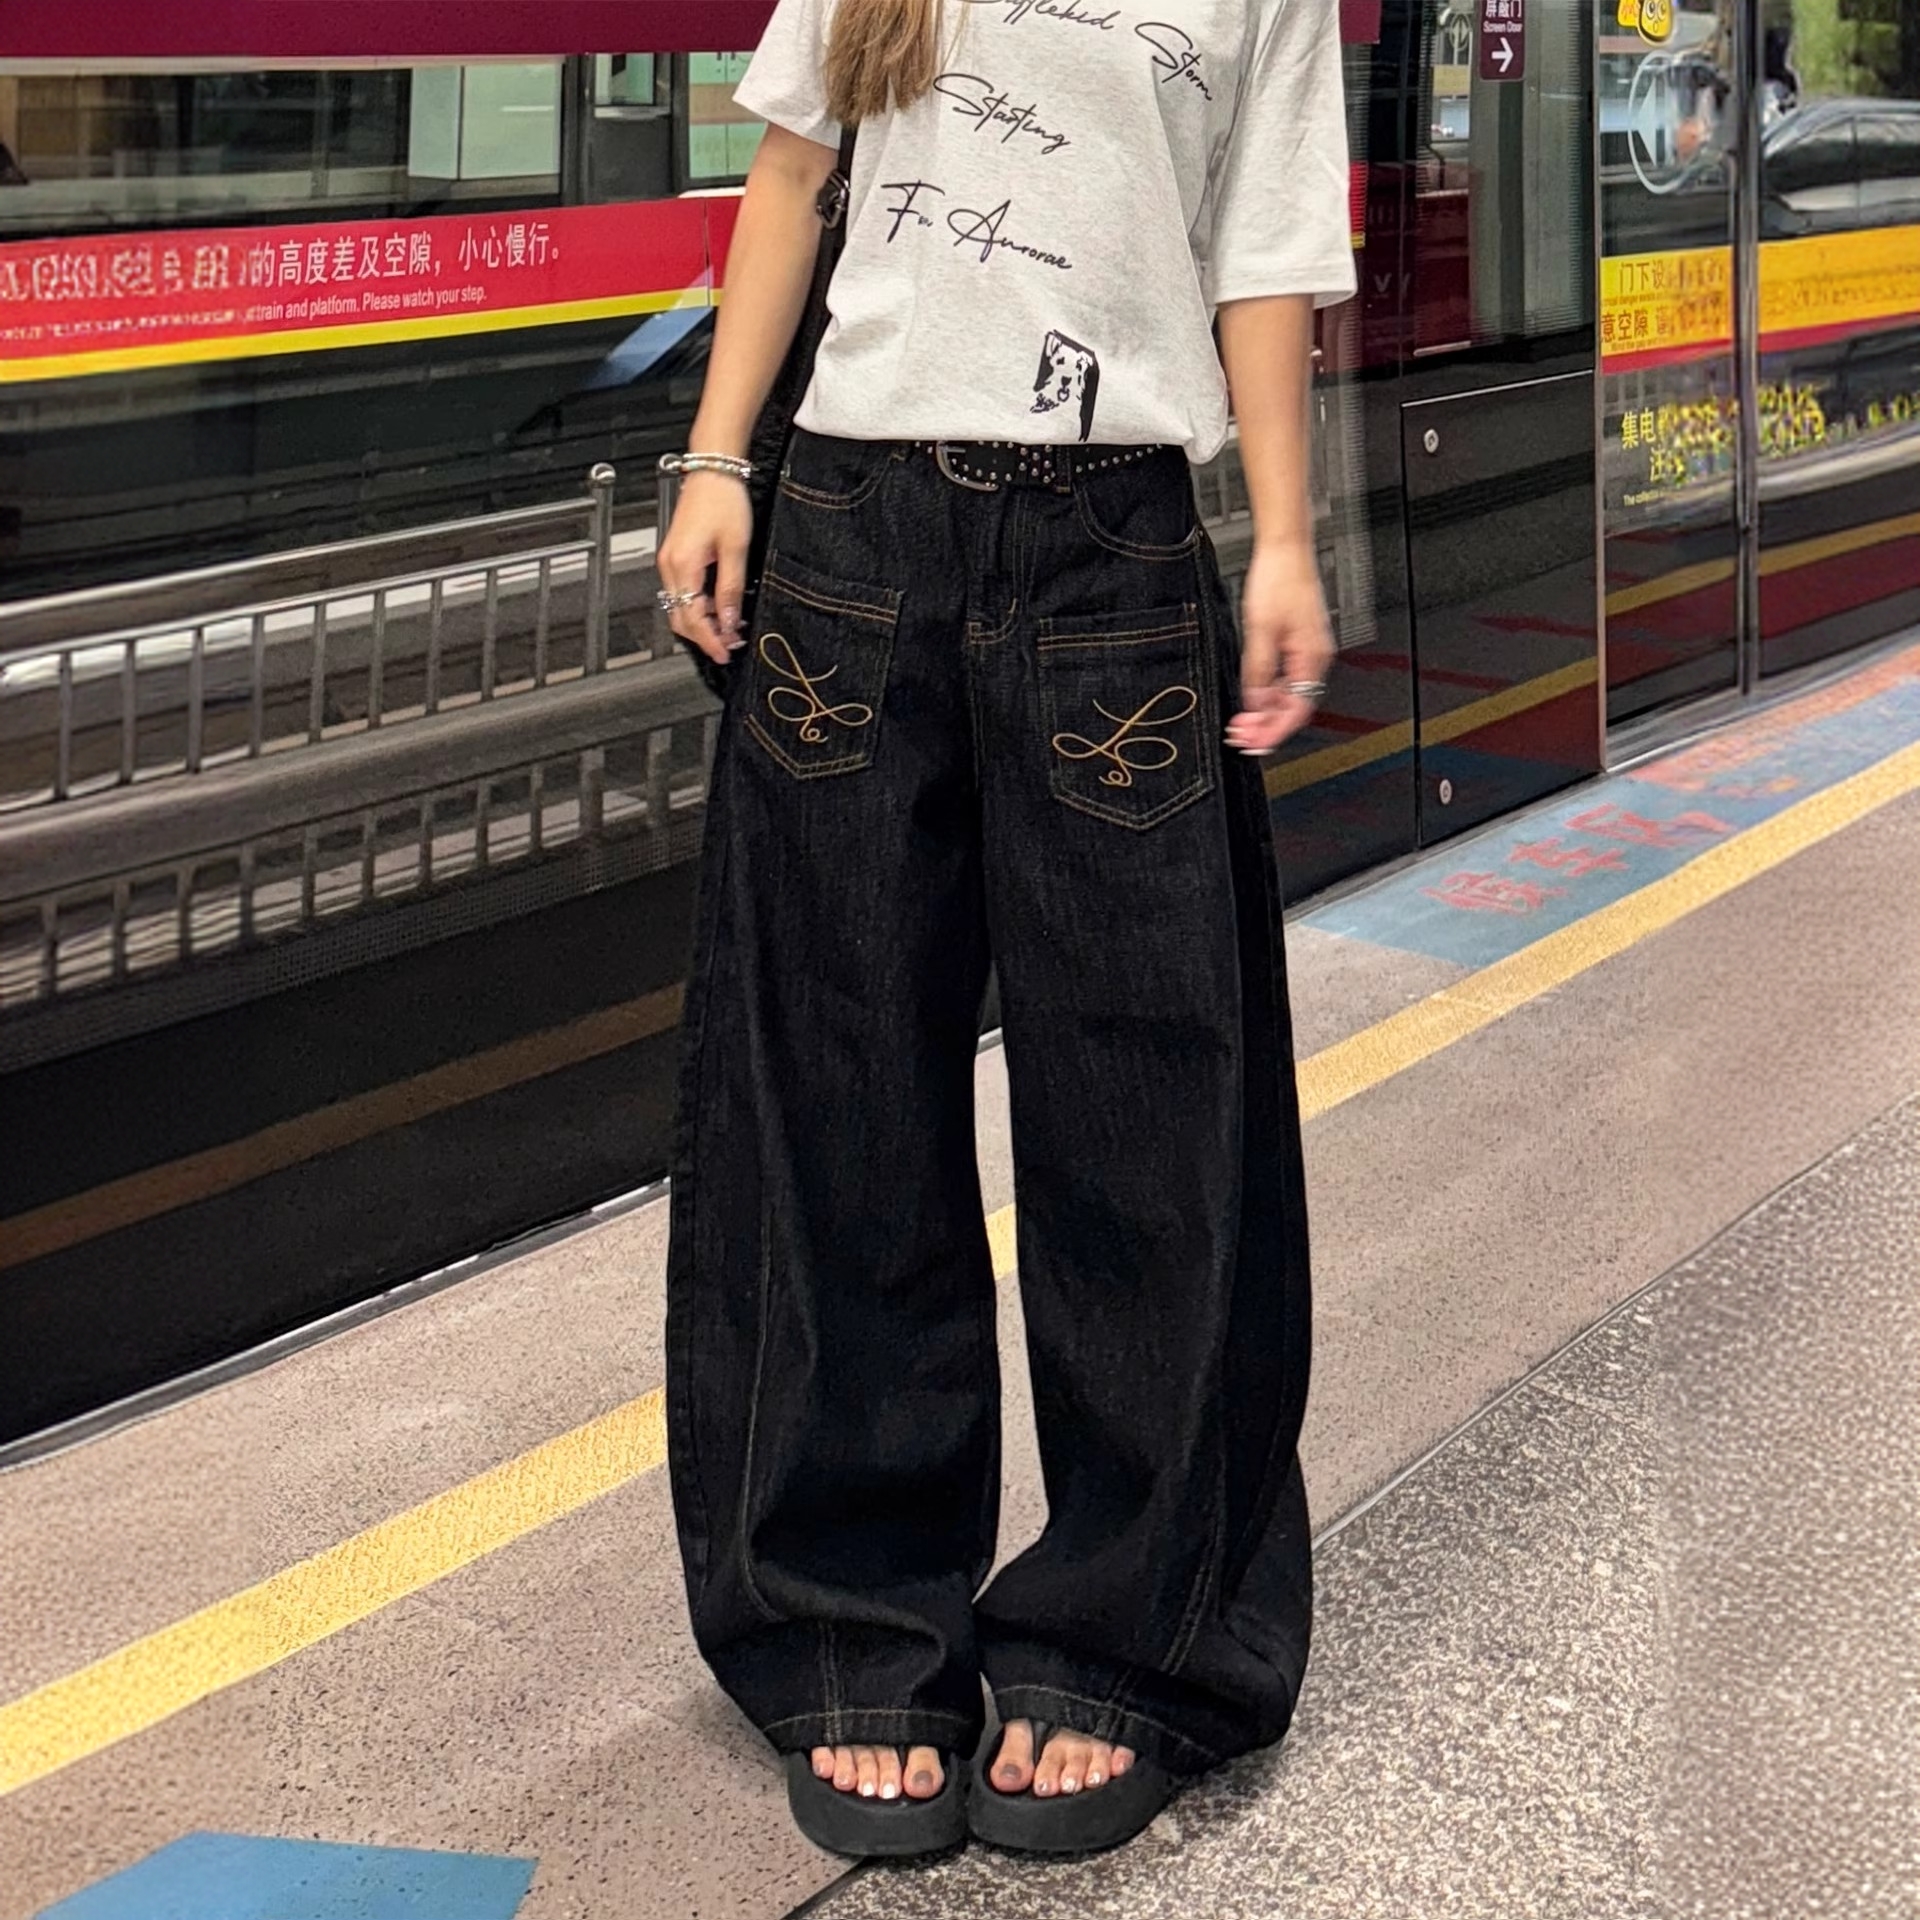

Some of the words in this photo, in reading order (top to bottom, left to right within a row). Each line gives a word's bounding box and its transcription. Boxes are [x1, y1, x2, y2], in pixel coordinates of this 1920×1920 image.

[1134, 21, 1212, 102] Storm
[933, 73, 1071, 154] Starting
[285, 298, 308, 319] and
[309, 295, 360, 321] platform.
[362, 292, 401, 311] Please
[402, 287, 434, 308] watch
[435, 288, 460, 309] your
[461, 284, 487, 304] step.
